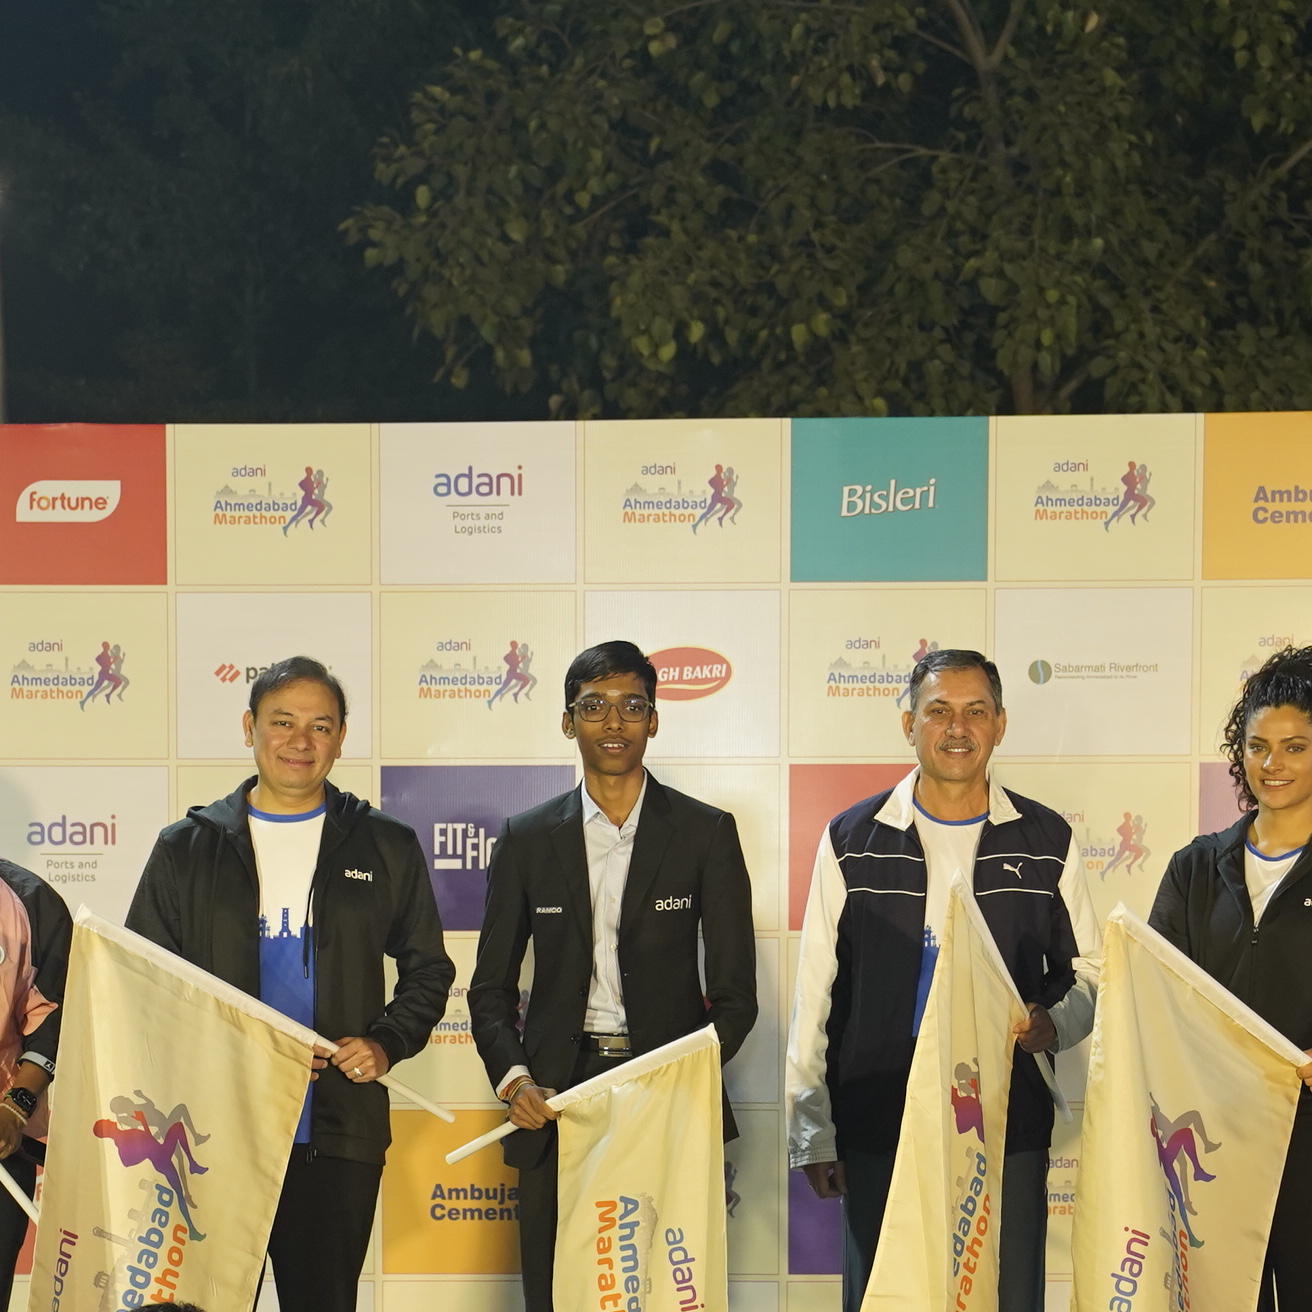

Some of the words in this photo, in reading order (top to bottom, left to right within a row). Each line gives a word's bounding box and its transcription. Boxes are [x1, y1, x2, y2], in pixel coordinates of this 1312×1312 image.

[231, 463, 267, 478] adani
[640, 462, 676, 476] adani
[1052, 459, 1089, 473] adani
[433, 465, 524, 497] adani
[28, 491, 108, 512] fortune
[622, 497, 708, 512] Ahmedabad
[839, 478, 936, 519] Bisleri
[1034, 494, 1120, 509] Ahmedabad
[213, 500, 298, 513] Ahmedabad
[213, 512, 287, 526] Marathon
[452, 511, 481, 522] Ports
[483, 511, 504, 522] and
[622, 510, 697, 524] Marathon
[1034, 507, 1109, 522] Marathon
[453, 523, 502, 536] Logistics
[27, 639, 64, 653] adani
[436, 638, 471, 653] adani
[681, 663, 727, 682] BAKRI
[1054, 663, 1106, 673] Sabarmati
[1109, 662, 1158, 673] Riverfront
[9, 674, 95, 688] Ahmedabad
[418, 673, 503, 688] Ahmedabad
[9, 686, 84, 700] Marathon
[418, 685, 492, 700] Marathon
[26, 814, 117, 847] adani
[433, 823, 464, 855] FIT
[467, 823, 476, 835] &
[45, 859, 74, 870] Ports
[76, 859, 98, 870] and
[48, 872, 97, 884] Logistics
[344, 867, 373, 883] adani
[655, 895, 692, 911] adani
[430, 1182, 520, 1204] Ambuja
[430, 1203, 521, 1222] Cement
[664, 1226, 706, 1312] adani
